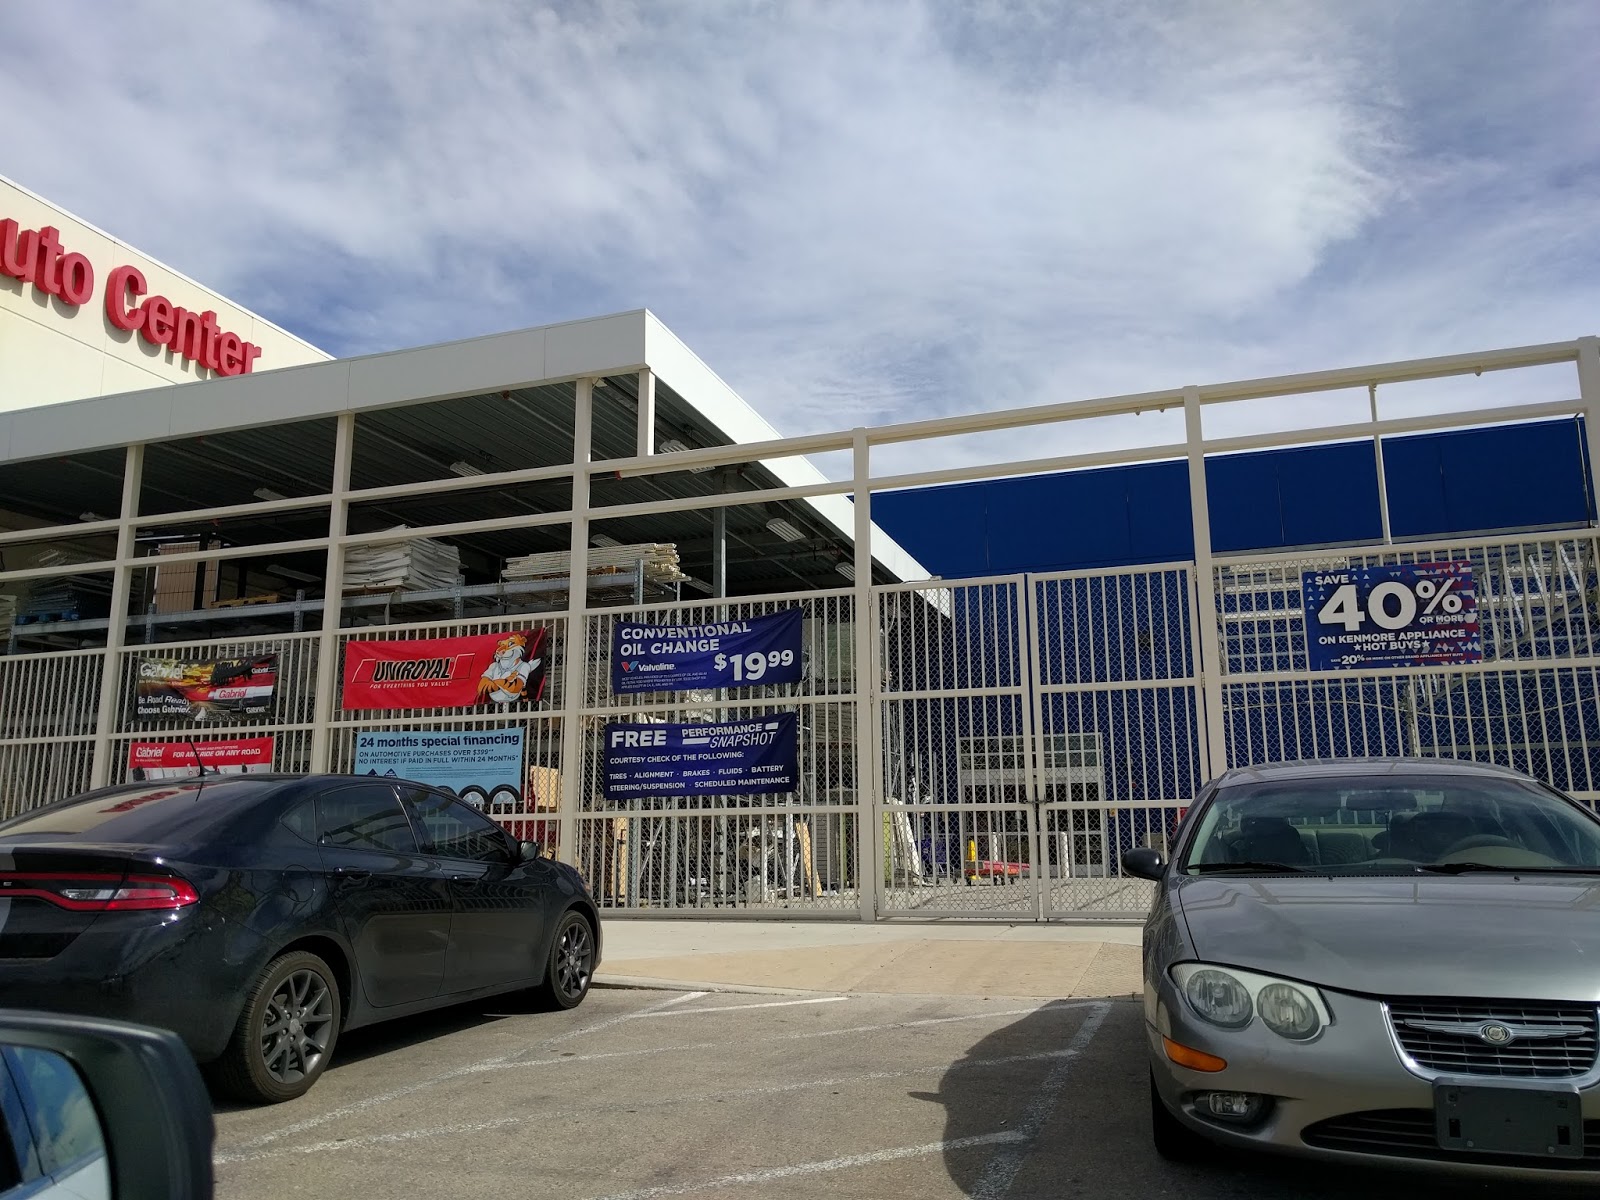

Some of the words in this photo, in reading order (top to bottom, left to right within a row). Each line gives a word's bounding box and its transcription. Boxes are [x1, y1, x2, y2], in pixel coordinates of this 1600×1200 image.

[0, 218, 94, 305] uto
[106, 265, 261, 377] Center
[1315, 574, 1349, 585] SAVE
[1317, 578, 1463, 632] 40%
[1419, 616, 1434, 624] OR
[1436, 614, 1464, 623] MORE
[621, 622, 752, 640] CONVENTIONAL
[1318, 636, 1336, 644] ON
[1338, 632, 1395, 644] KENMORE
[1398, 629, 1466, 640] APPLIANCE
[620, 644, 646, 656] OIL
[650, 639, 720, 654] CHANGE
[1363, 642, 1387, 651] HOT
[1390, 640, 1422, 650] BUYS
[1342, 654, 1365, 664] 20%
[373, 658, 452, 682] UNIROYAL
[638, 663, 674, 672] Valvoline
[147, 695, 163, 704] Road
[219, 689, 247, 699] Gabriel
[138, 706, 160, 714] Choose
[360, 737, 374, 748] 24
[377, 736, 418, 748] months
[422, 735, 460, 748] special
[462, 734, 520, 746] financing
[611, 730, 667, 748] FREE
[682, 723, 762, 737] PERFORMANCE
[710, 732, 776, 748] SNAPSHOT
[136, 747, 164, 758] Gabriel
[698, 751, 744, 760] FOLLOWING:
[751, 765, 784, 773] BATTERY
[610, 782, 685, 792] STEERING/SUSPENSION
[694, 780, 736, 788] SCHEDULED
[738, 776, 790, 785] MAINTENANCE
